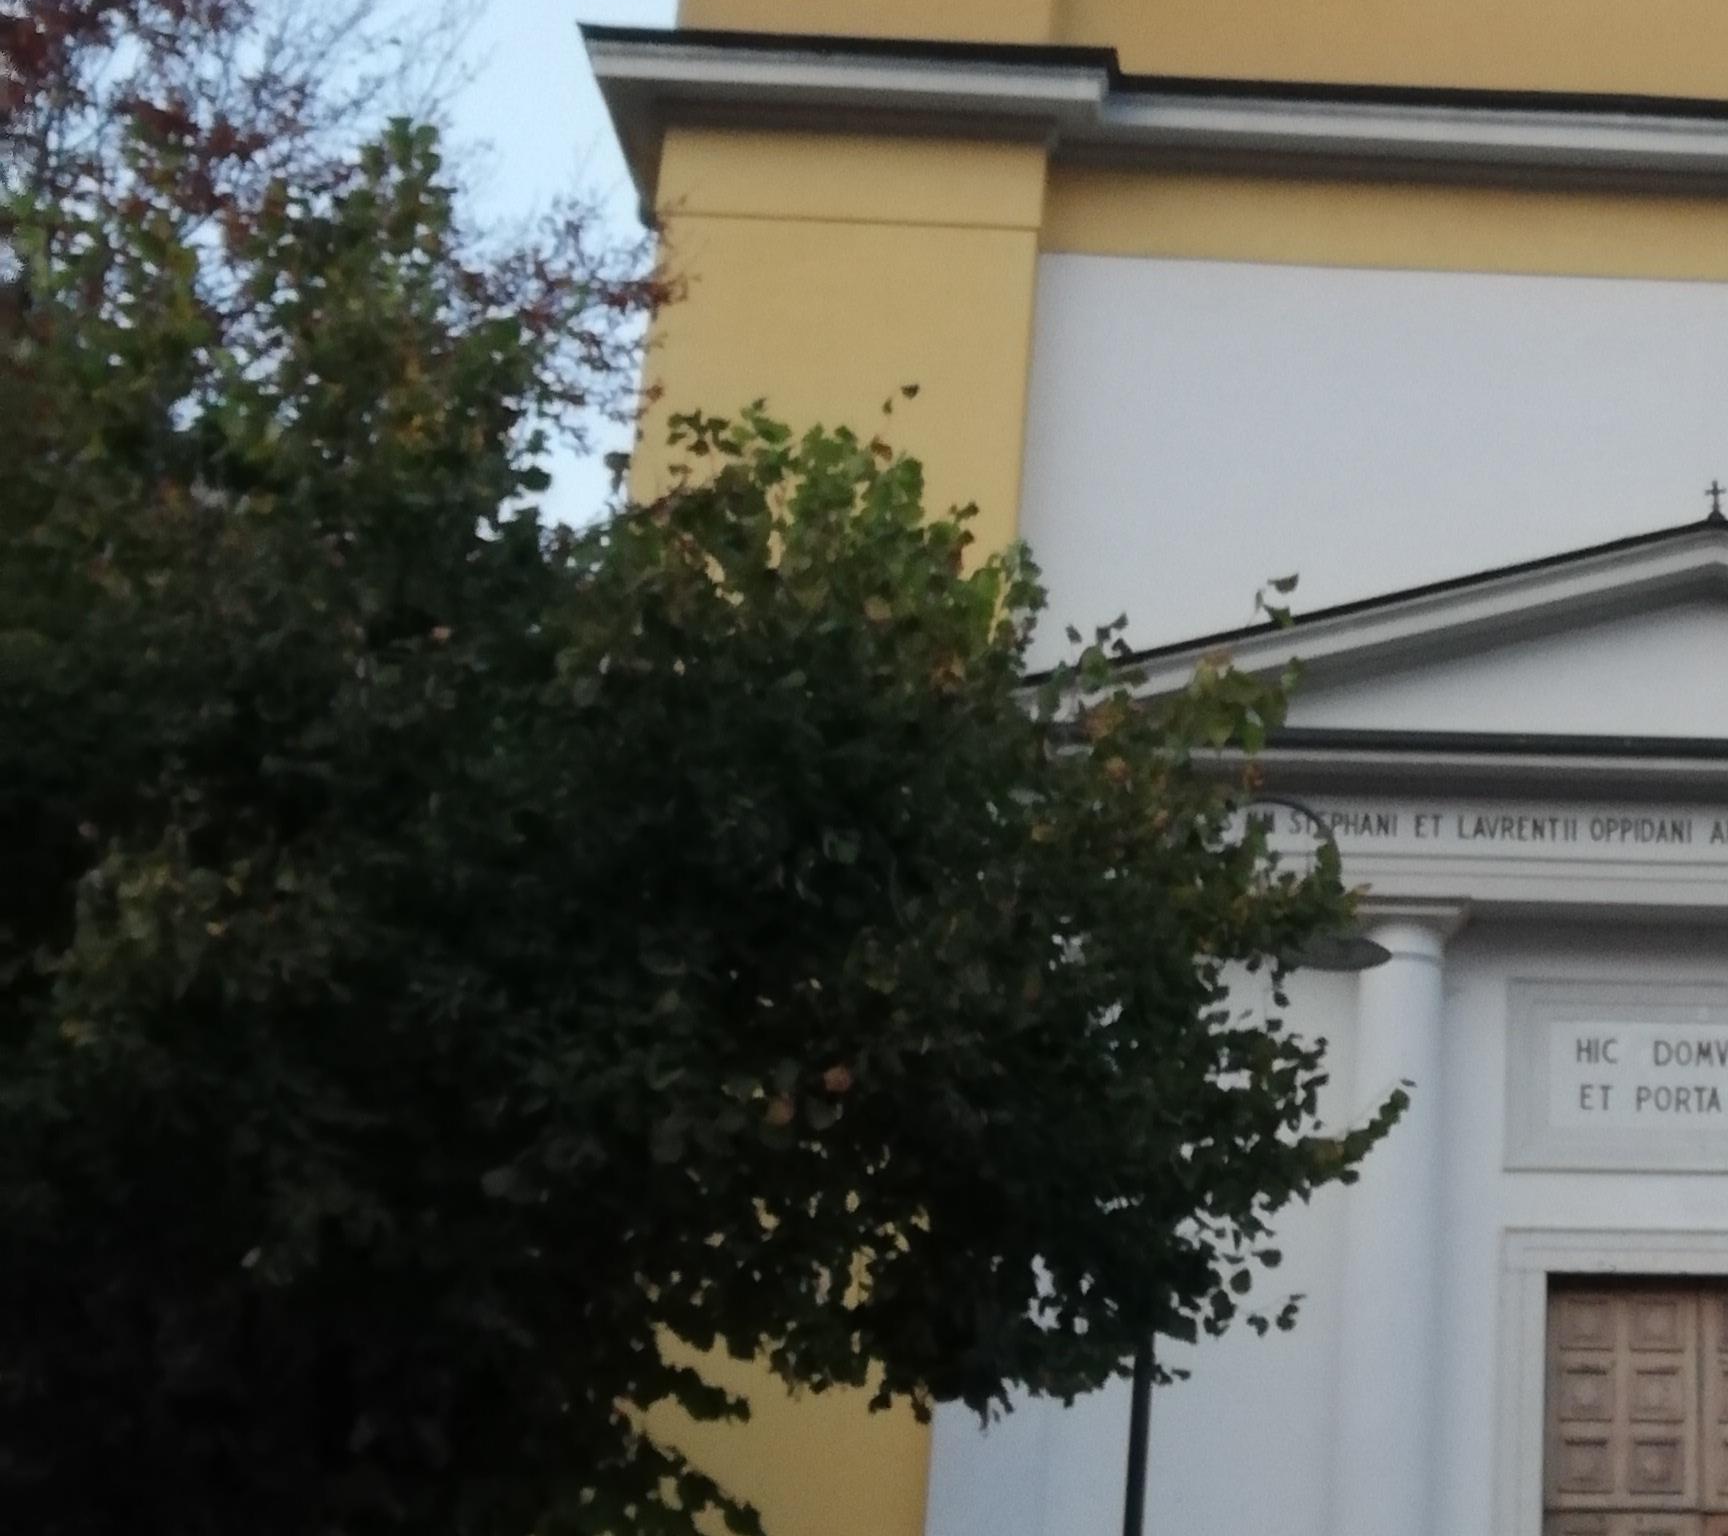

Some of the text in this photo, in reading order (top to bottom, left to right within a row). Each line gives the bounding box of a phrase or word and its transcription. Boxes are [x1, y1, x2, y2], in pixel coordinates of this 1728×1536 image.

[1414, 814, 1441, 838] ET
[1457, 815, 1578, 841] LAVRENTII
[1589, 818, 1693, 844] OPPIDANI
[1575, 1038, 1619, 1064] HIC
[1579, 1084, 1614, 1111] ET
[1636, 1086, 1722, 1113] PORTA
